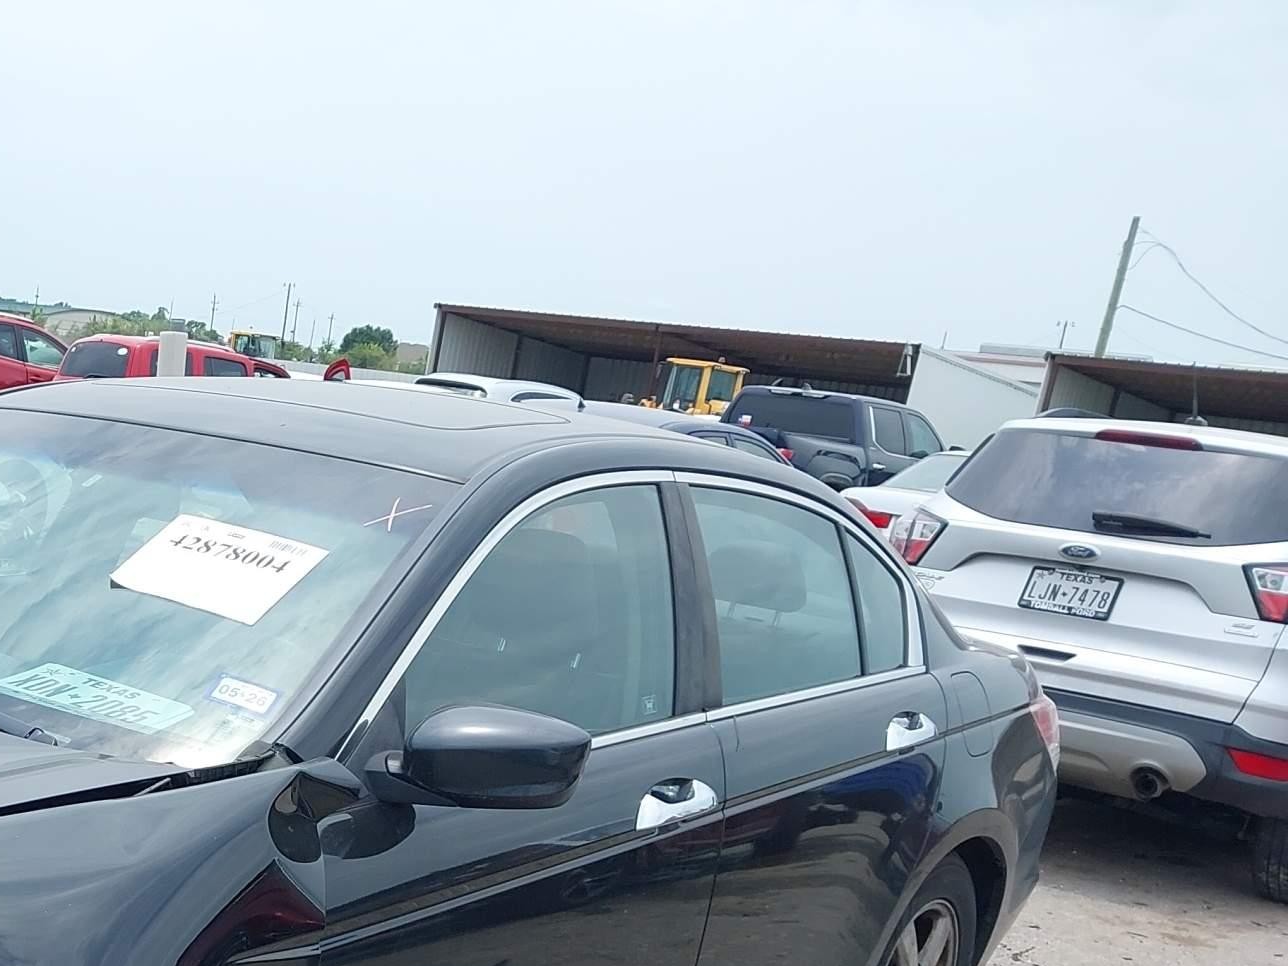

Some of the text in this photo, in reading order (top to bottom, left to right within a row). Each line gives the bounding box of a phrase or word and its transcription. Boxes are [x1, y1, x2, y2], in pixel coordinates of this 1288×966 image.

[170, 534, 291, 573] 42878004
[1060, 572, 1094, 585] TEXAS
[1070, 607, 1096, 617] FORD
[81, 677, 141, 701] TEXAS
